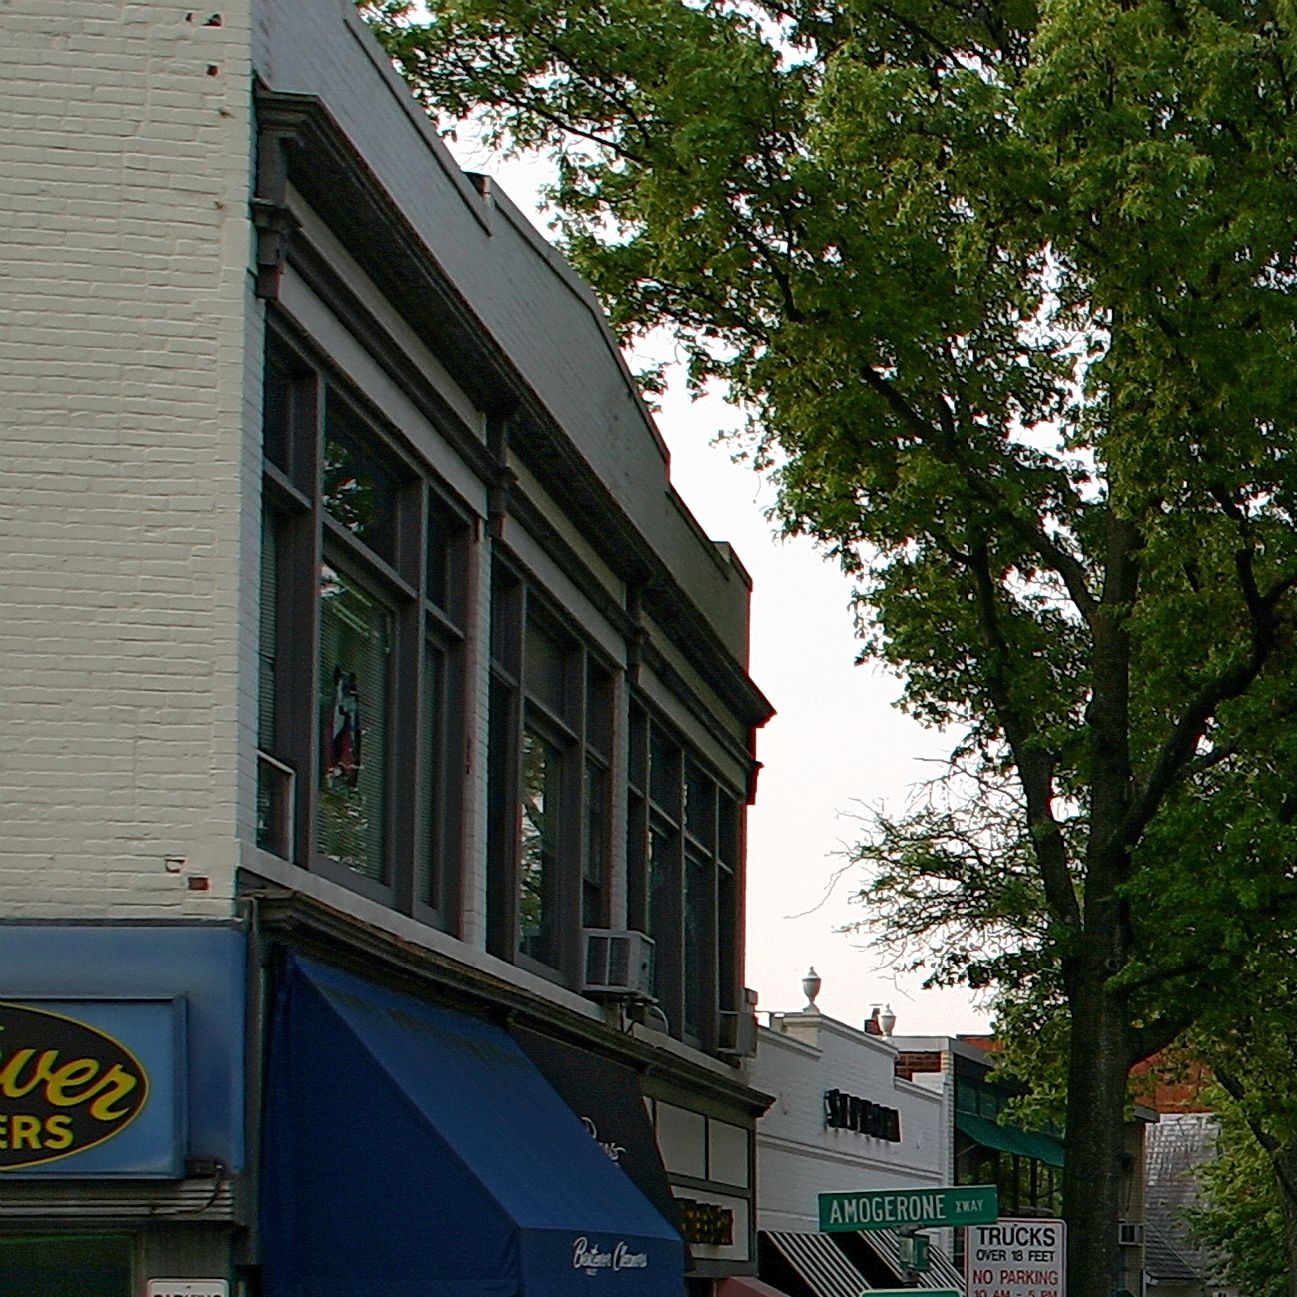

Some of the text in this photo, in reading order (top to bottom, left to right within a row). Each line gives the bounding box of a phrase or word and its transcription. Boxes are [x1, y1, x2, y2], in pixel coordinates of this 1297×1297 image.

[830, 1195, 984, 1224] AMOGERONE XWAY
[977, 1227, 1055, 1246] TRUCKS
[976, 1249, 1006, 1262] OVER
[1028, 1251, 1055, 1262] FEET
[973, 1270, 1058, 1285] NO PARKING
